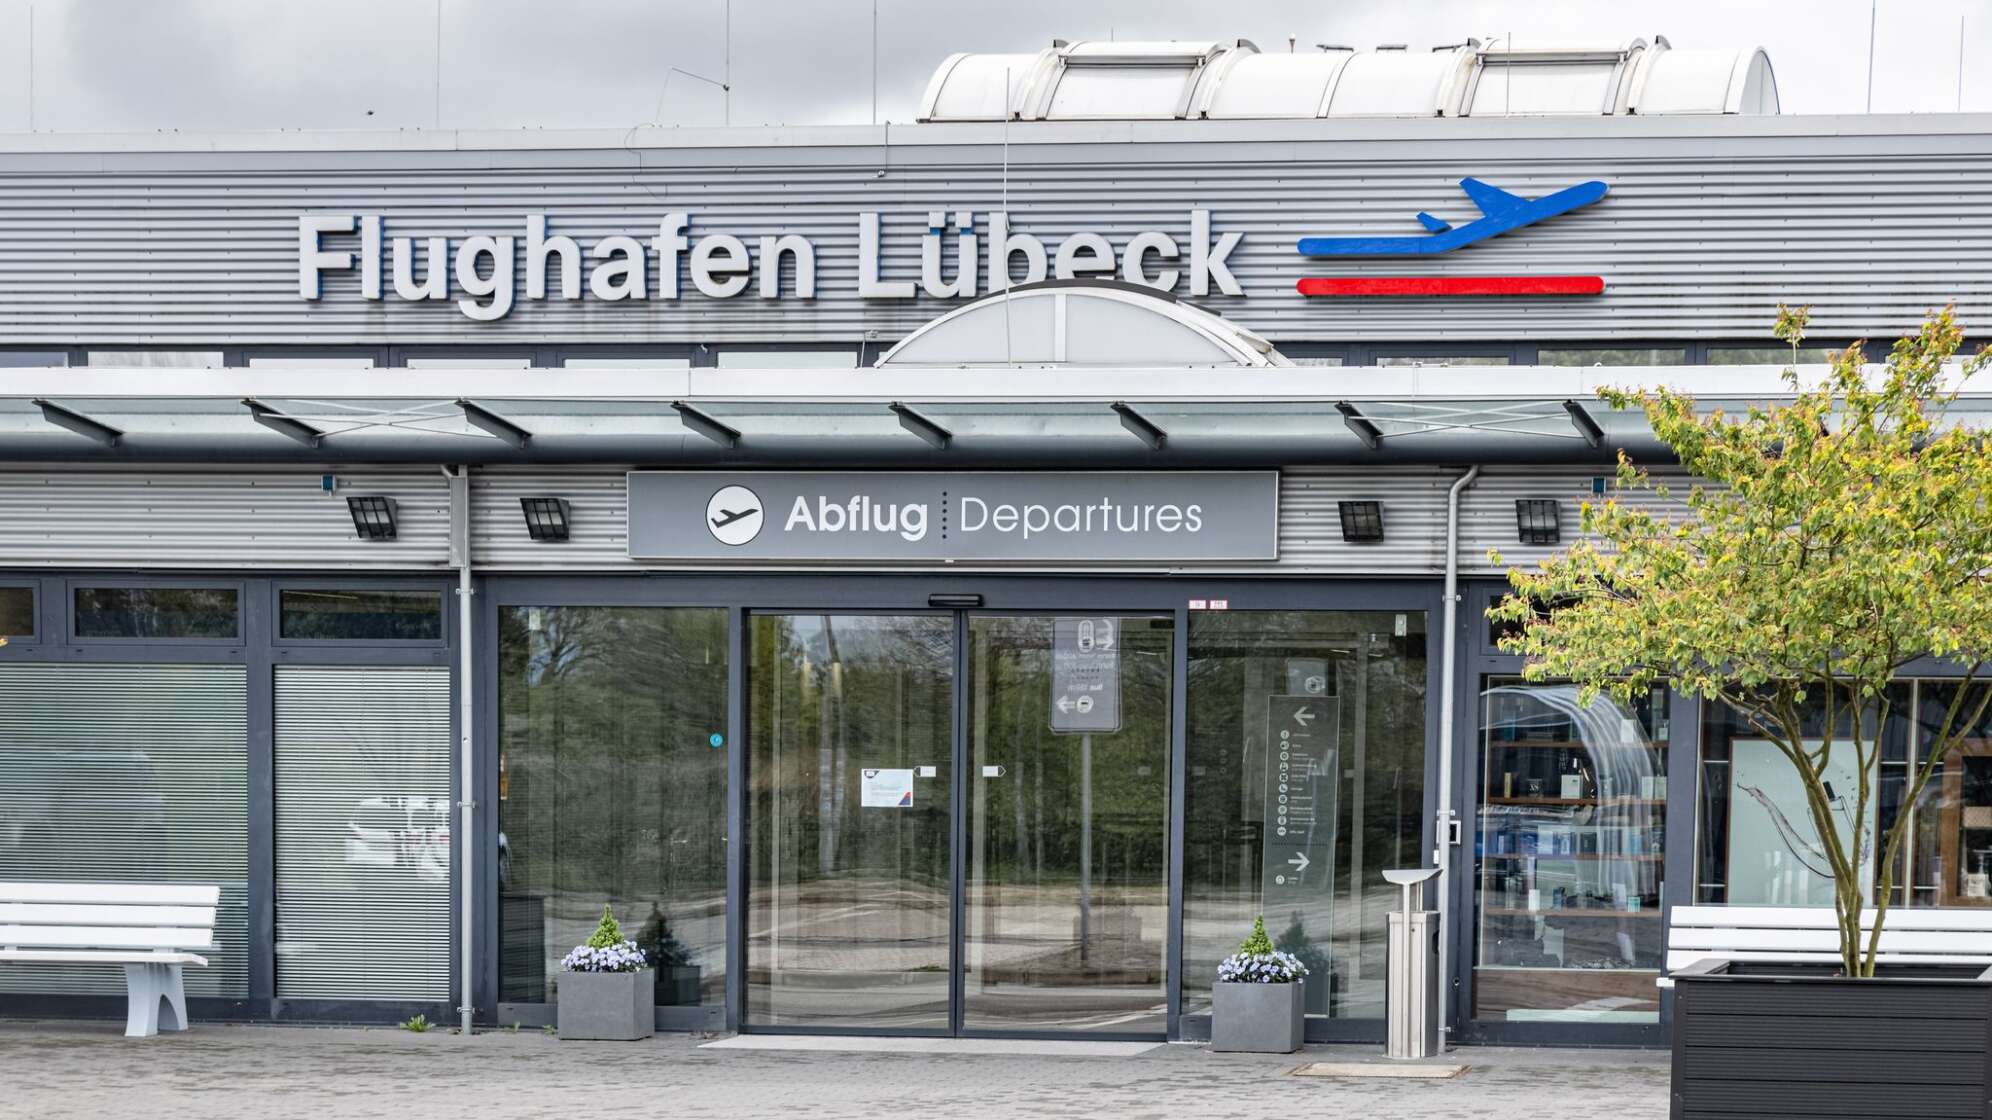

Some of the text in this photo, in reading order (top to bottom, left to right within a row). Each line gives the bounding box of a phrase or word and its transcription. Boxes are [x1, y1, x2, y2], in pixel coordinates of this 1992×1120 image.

[299, 209, 1247, 321] Flughafen Lübeck
[784, 495, 1203, 542] Abflug Departures
